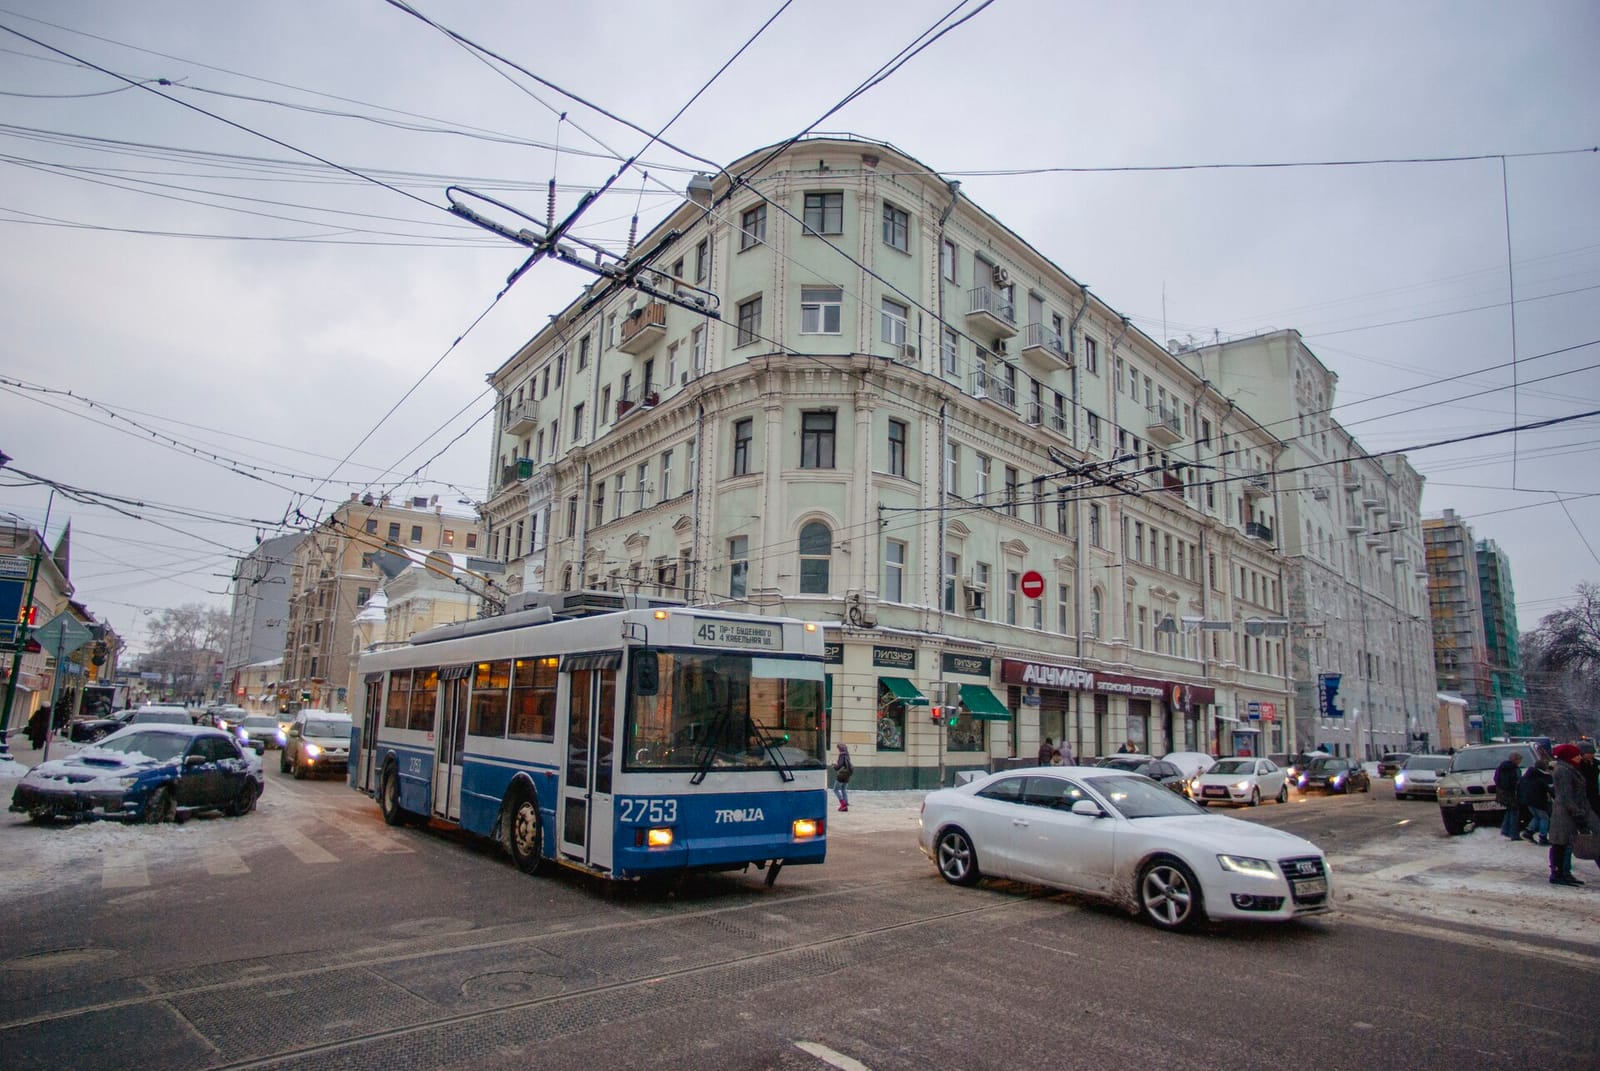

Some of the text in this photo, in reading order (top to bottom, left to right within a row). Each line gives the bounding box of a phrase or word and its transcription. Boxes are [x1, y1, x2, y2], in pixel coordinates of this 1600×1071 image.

[698, 624, 716, 641] 45
[873, 649, 913, 662] ПИЛЗНЕР
[954, 657, 982, 668] ПИЛЗНЕР
[1022, 664, 1094, 690] АЦУМАРИ
[620, 799, 678, 823] 2753
[715, 807, 764, 824] TROLZA
